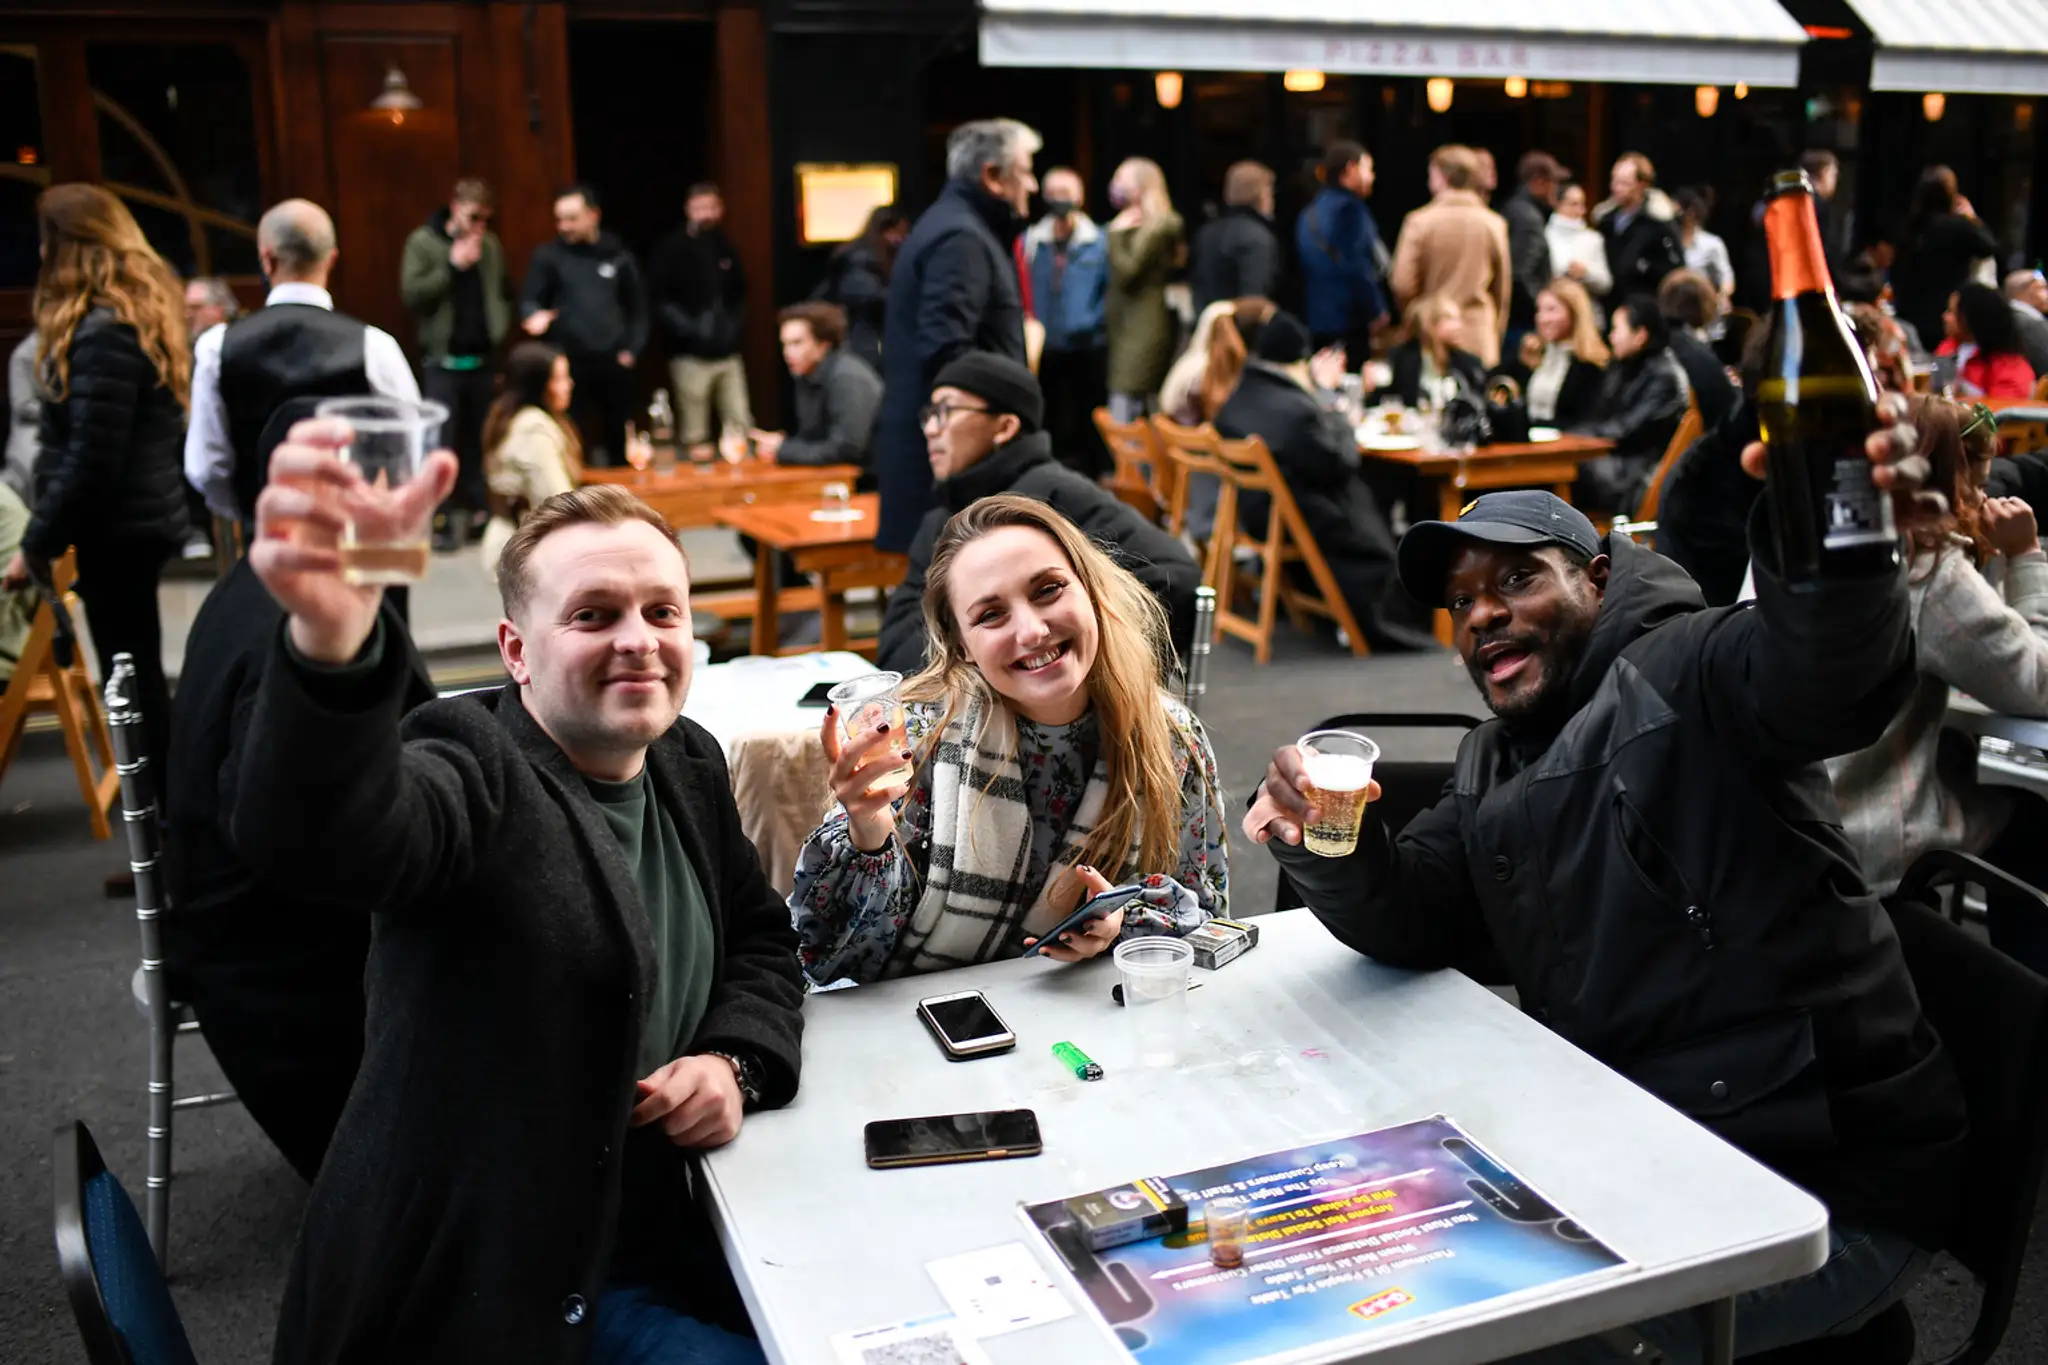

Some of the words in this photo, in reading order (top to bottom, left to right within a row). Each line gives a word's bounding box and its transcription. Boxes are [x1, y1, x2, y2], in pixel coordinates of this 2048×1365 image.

[1324, 39, 1437, 65] PIZZA
[1457, 43, 1531, 69] BAR
[1313, 1158, 1347, 1171] Keep
[1245, 1165, 1315, 1186] Customers
[1308, 1177, 1328, 1187] Do
[1200, 1184, 1234, 1198] Staff
[1248, 1186, 1285, 1200] Right
[1282, 1181, 1312, 1192] The
[1371, 1190, 1395, 1200] Will
[1293, 1208, 1315, 1217] To
[1311, 1199, 1352, 1214] Asked
[1346, 1204, 1393, 1219] Anyone
[1321, 1214, 1348, 1225] Not
[1419, 1218, 1454, 1233] Must
[1450, 1213, 1478, 1224] You
[1280, 1220, 1325, 1235] Social
[1378, 1226, 1421, 1243] Social
[1321, 1236, 1381, 1255] Distance
[1377, 1242, 1418, 1257] When
[1285, 1250, 1323, 1264] From
[1335, 1257, 1353, 1269] At
[1352, 1252, 1380, 1264] Not
[1249, 1258, 1287, 1273] Other
[1304, 1262, 1337, 1276] Your
[1172, 1268, 1248, 1291] Customers
[1264, 1269, 1304, 1284] Table
[1315, 1271, 1366, 1288] People
[1291, 1282, 1318, 1294] Per
[1250, 1289, 1290, 1304] Table
